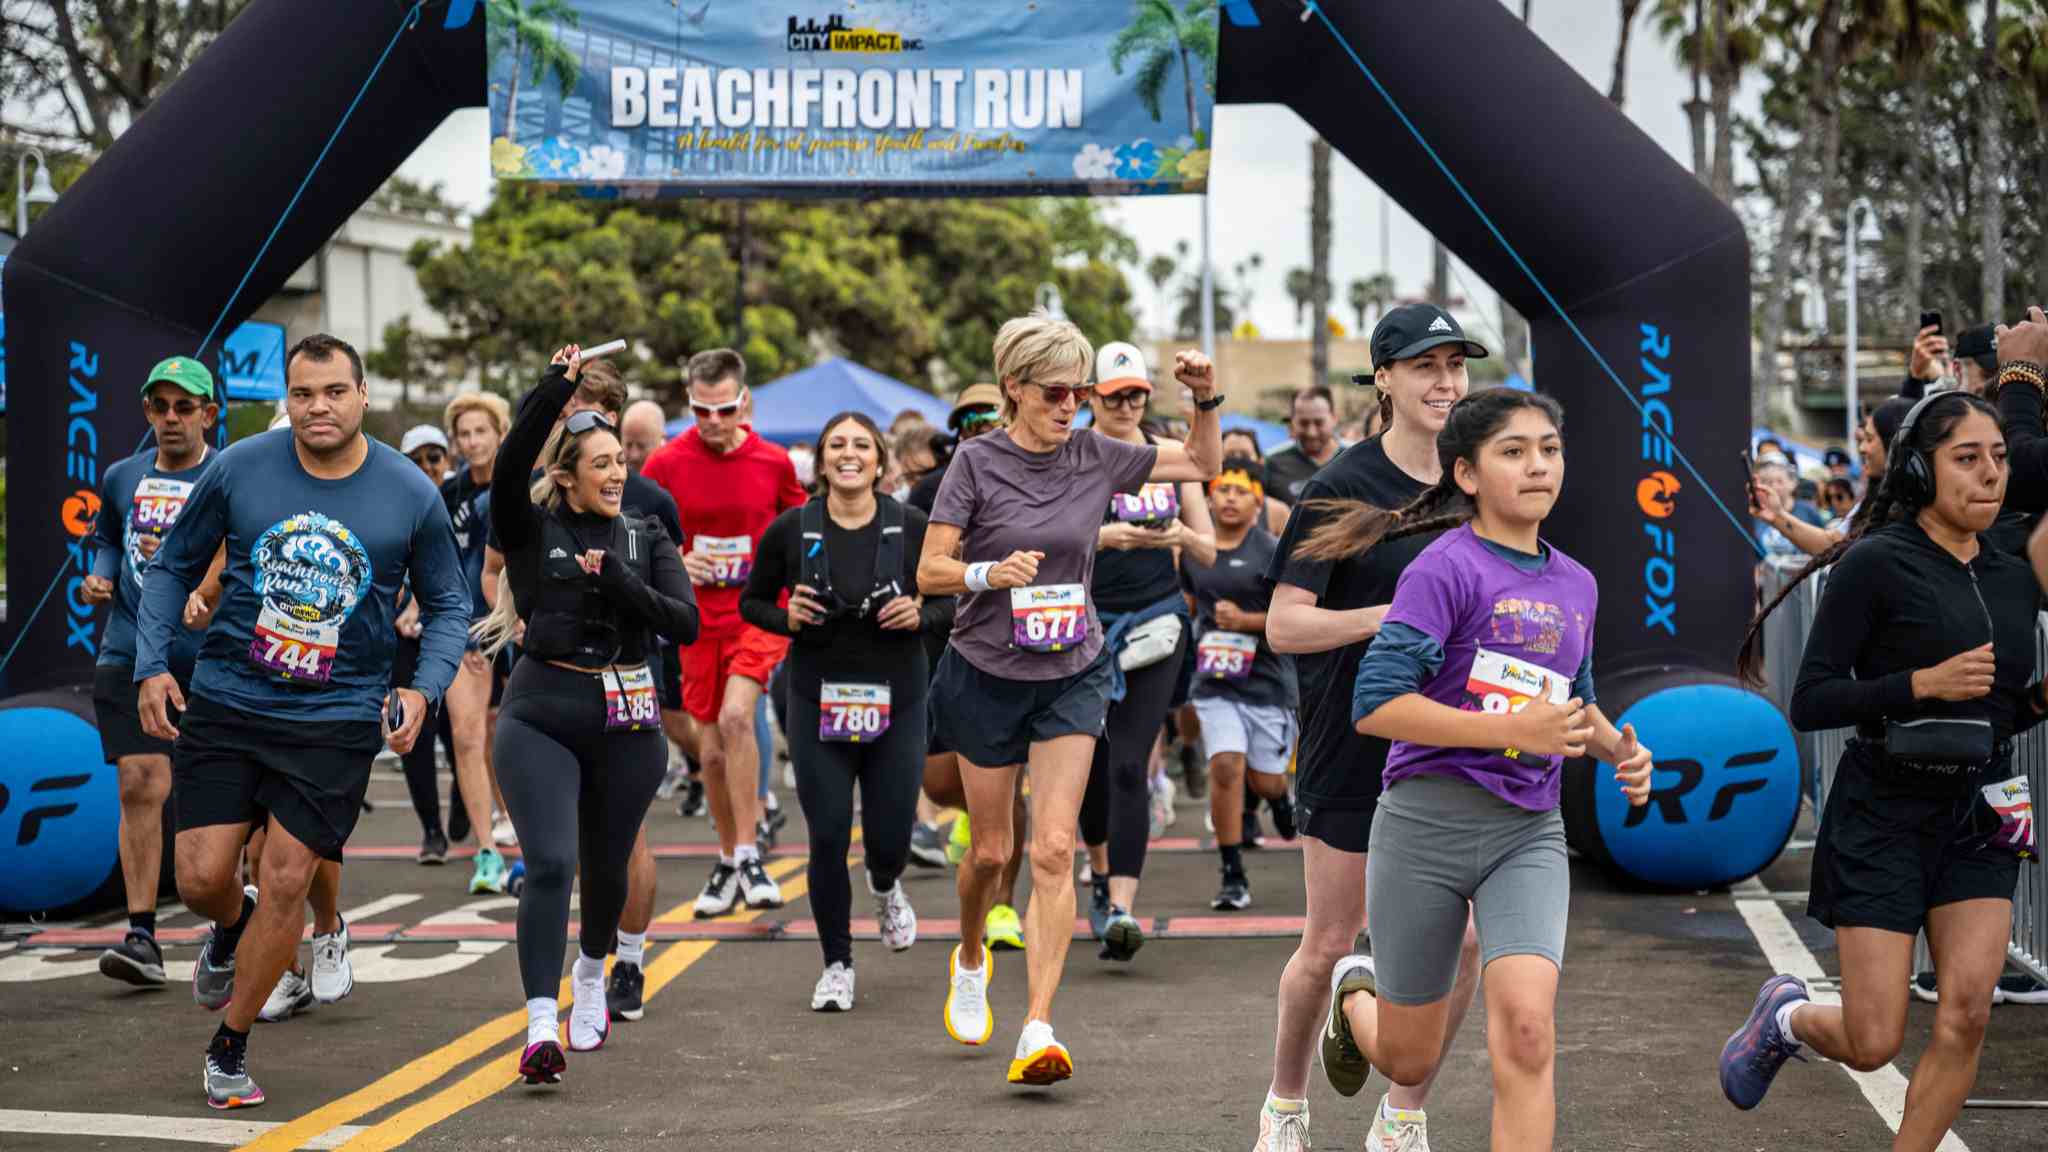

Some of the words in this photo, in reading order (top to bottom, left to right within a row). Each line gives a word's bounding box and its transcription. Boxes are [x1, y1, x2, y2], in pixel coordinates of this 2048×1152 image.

[789, 32, 829, 49] CITY
[611, 66, 965, 129] BEACHFRONT
[975, 68, 1084, 129] RUN
[68, 341, 99, 486] RACE
[1640, 322, 1674, 469] RACE
[138, 498, 182, 524] 542
[67, 543, 96, 657] FOX
[1644, 523, 1677, 637] FOX
[1026, 609, 1077, 641] 677
[263, 635, 321, 675] 744
[1203, 650, 1244, 673] 733
[830, 703, 880, 733] 780
[1623, 748, 1779, 829] RF
